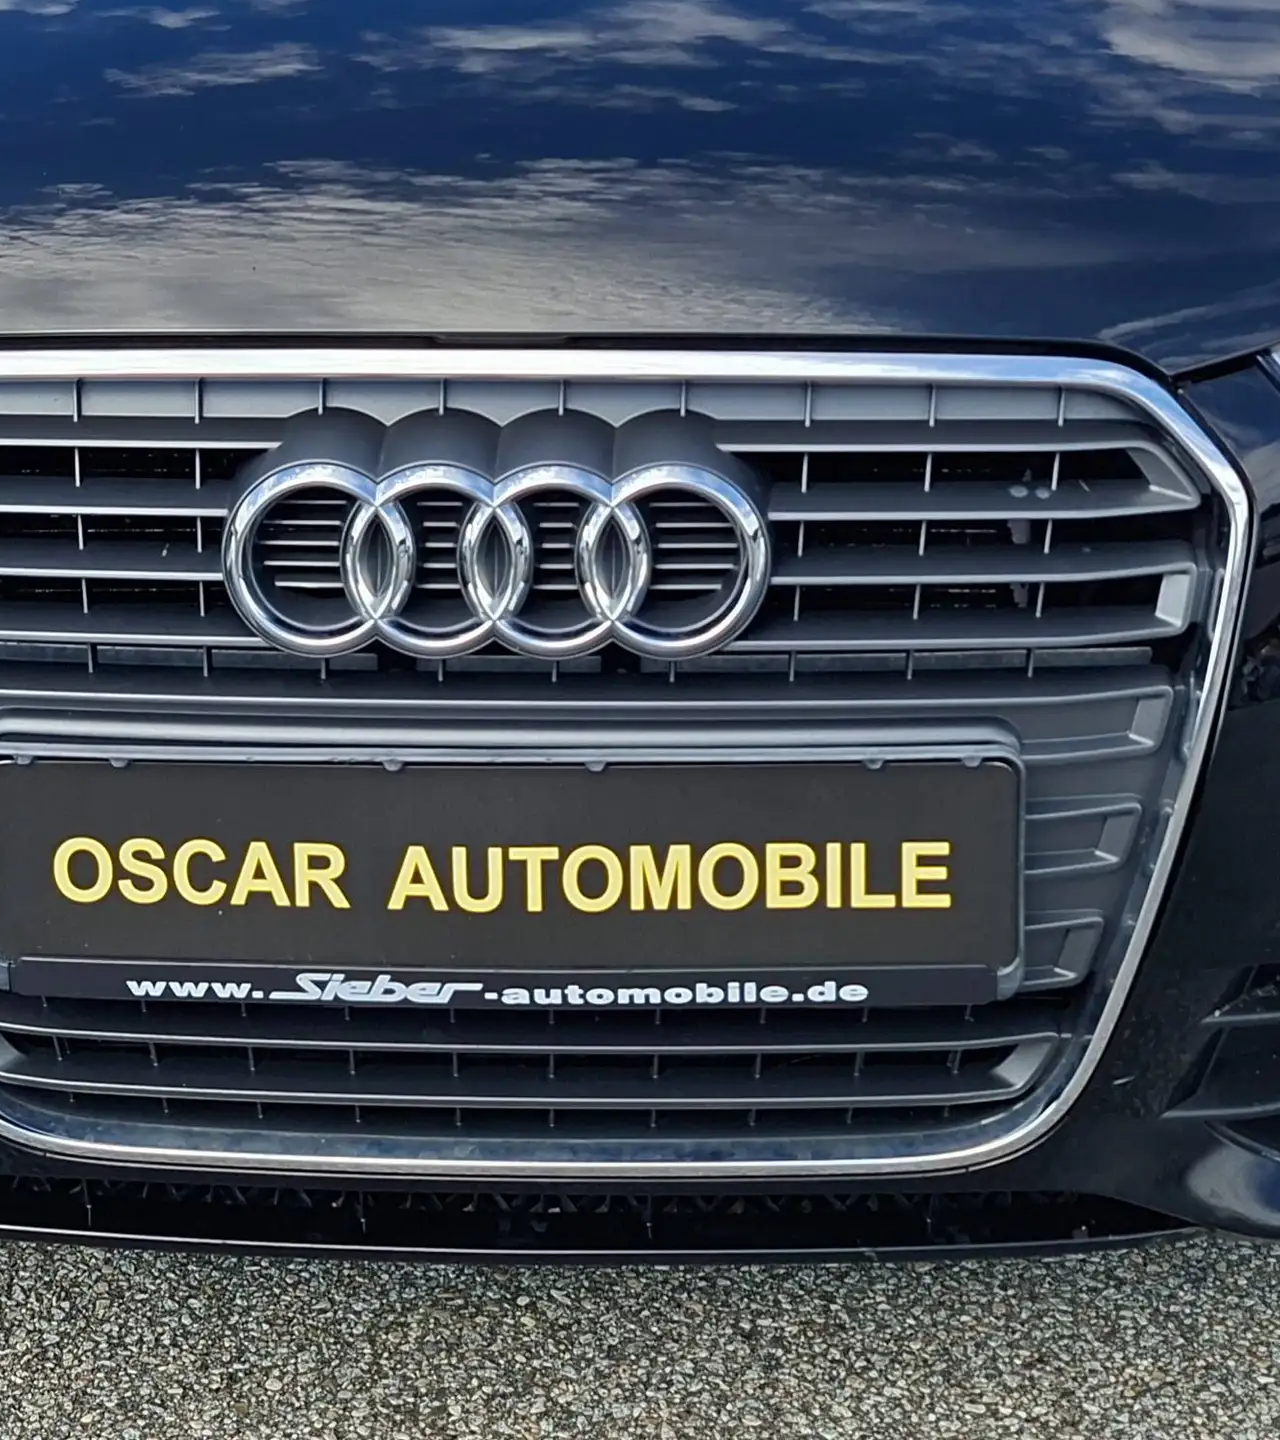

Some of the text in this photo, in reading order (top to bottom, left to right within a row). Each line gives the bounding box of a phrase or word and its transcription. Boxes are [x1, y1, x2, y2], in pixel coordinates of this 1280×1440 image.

[52, 836, 952, 913] OSCAR AUTOMOBILE
[126, 972, 869, 1006] www.Sieber-automobile.de
